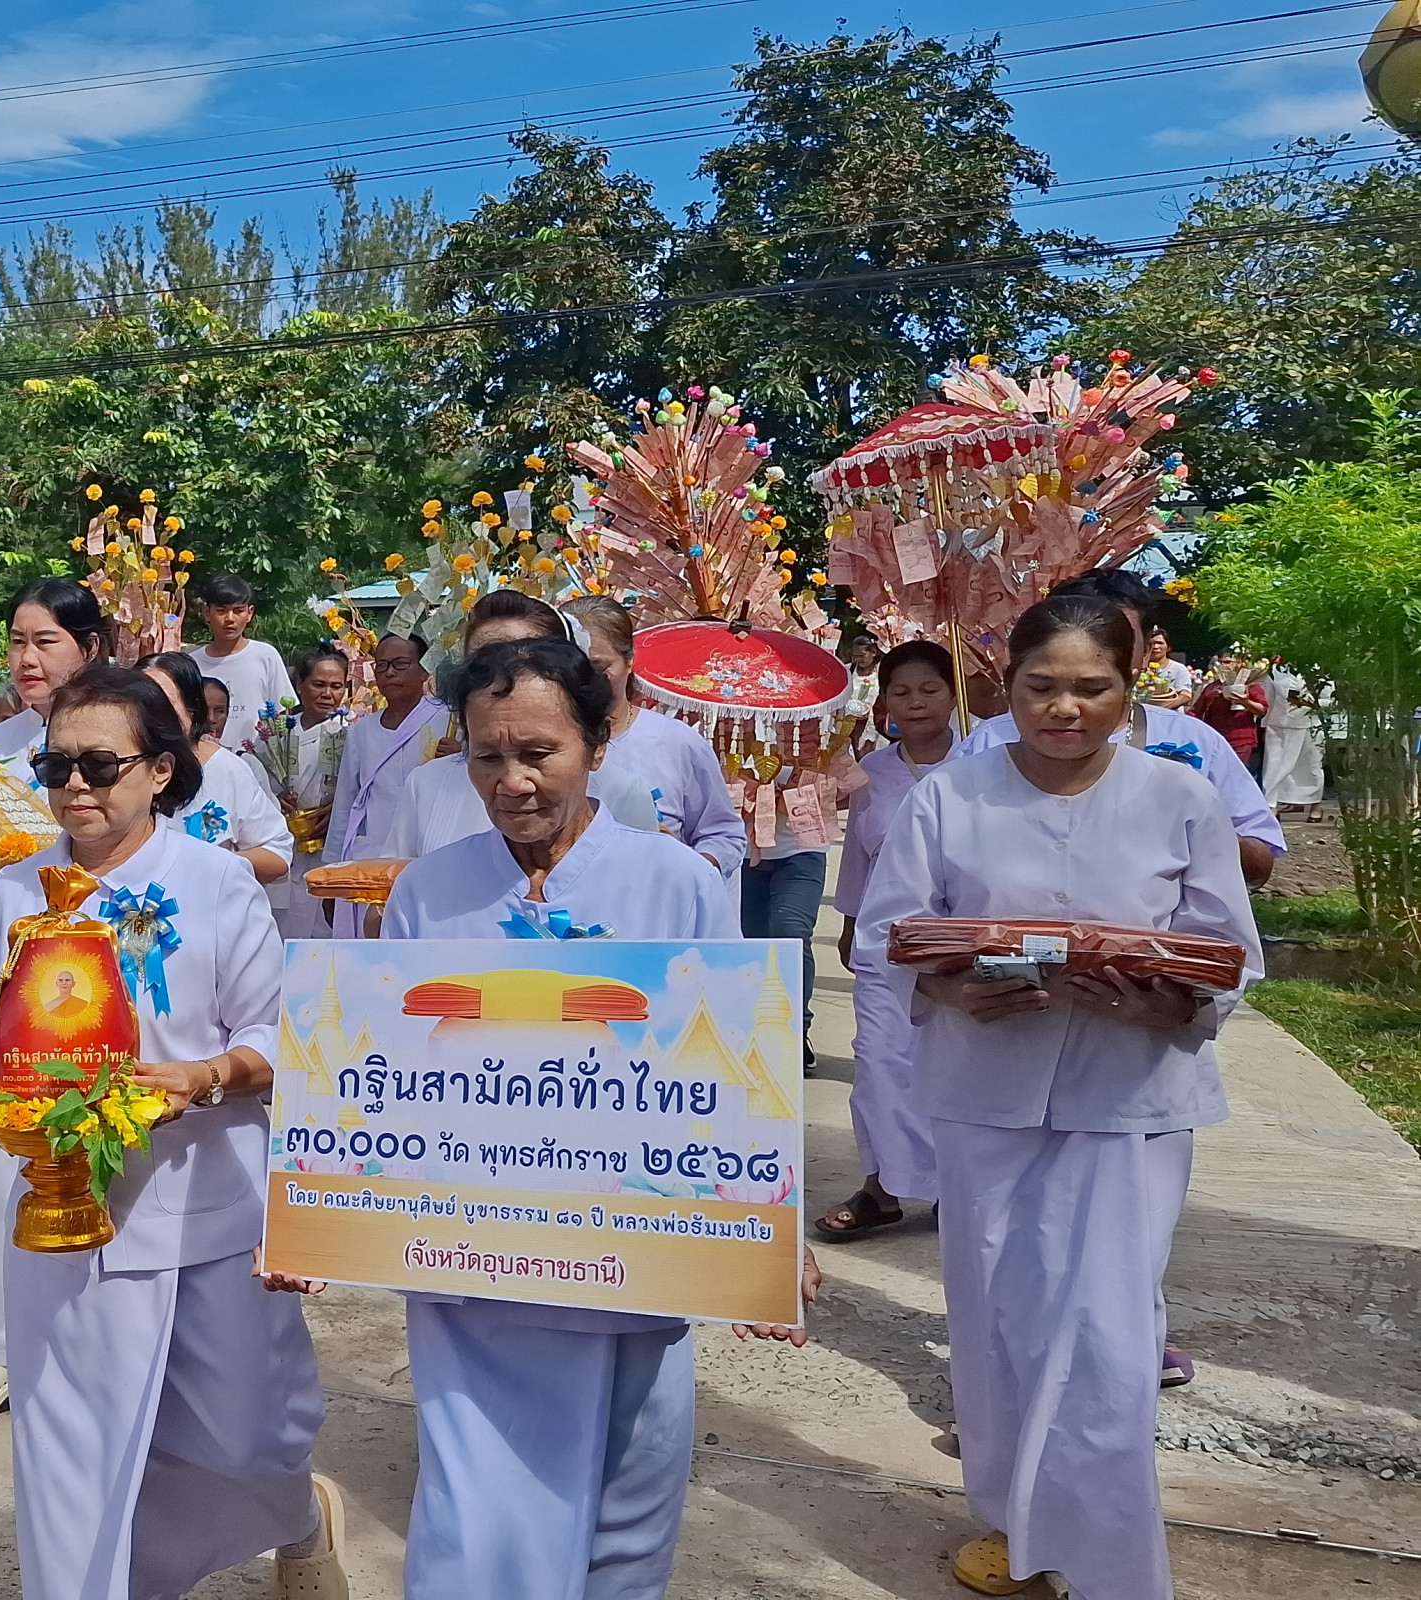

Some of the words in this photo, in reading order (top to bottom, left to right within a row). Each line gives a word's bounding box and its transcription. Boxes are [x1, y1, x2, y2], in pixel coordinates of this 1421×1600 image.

[338, 1047, 718, 1116] กฐินสามัคคีทั่วไทย
[286, 1126, 426, 1164] ๓๐,๐๐๐
[438, 1131, 469, 1163] วัด
[479, 1137, 627, 1177] พุทธศักราช
[643, 1142, 780, 1183] ๒๕๖๘
[287, 1183, 318, 1206] โดย
[323, 1190, 456, 1217] คณะศิษยานุศิษย์
[464, 1200, 548, 1225] บูชาธรรม
[556, 1209, 583, 1227] ๘๑
[591, 1206, 605, 1228] ปี
[612, 1211, 771, 1241] หลวงพ่อธัมมชโย
[404, 1240, 626, 1288] (จังหวัดอุบลราชธานี)
